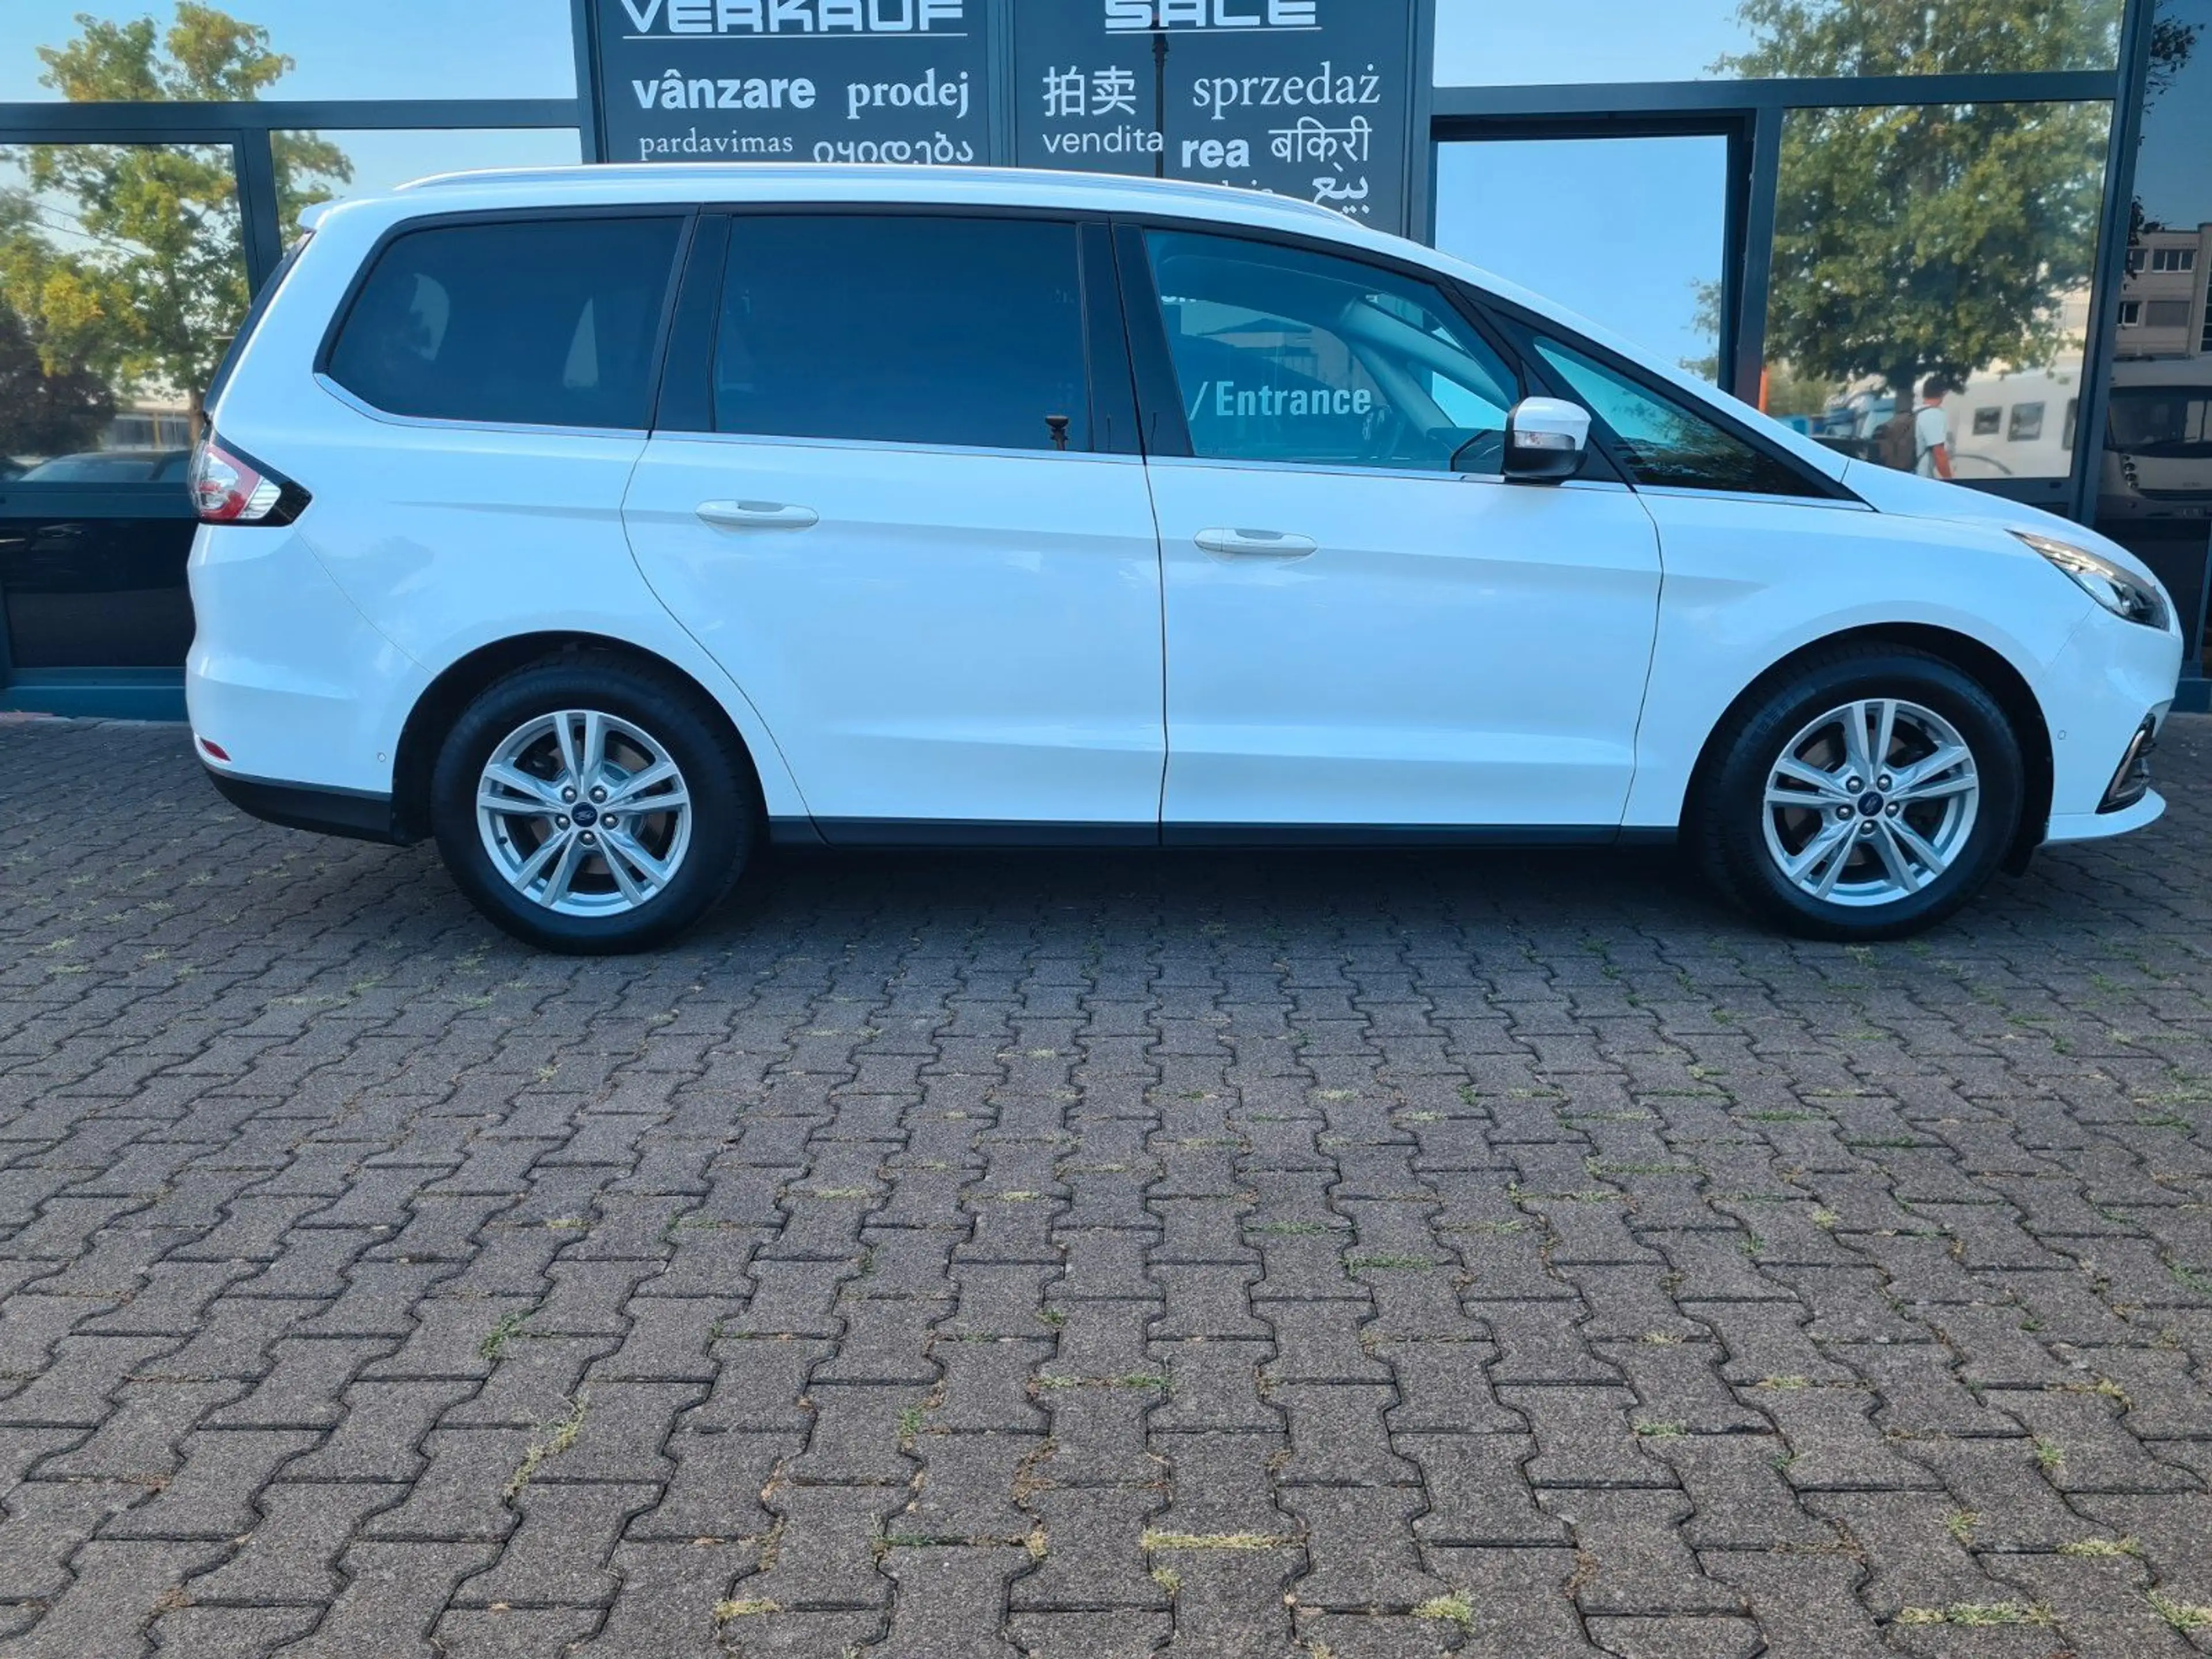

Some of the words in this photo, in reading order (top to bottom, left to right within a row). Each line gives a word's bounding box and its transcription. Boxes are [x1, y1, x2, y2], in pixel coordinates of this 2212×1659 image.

[1105, 0, 1316, 28] SALE
[632, 69, 816, 109] vânzare
[847, 68, 968, 119] prodej
[1043, 66, 1137, 116] 拍卖
[1193, 61, 1381, 120] sprzedaż
[639, 127, 793, 161] pardavimas
[1043, 126, 1164, 153] vendita
[1182, 139, 1250, 168] rea
